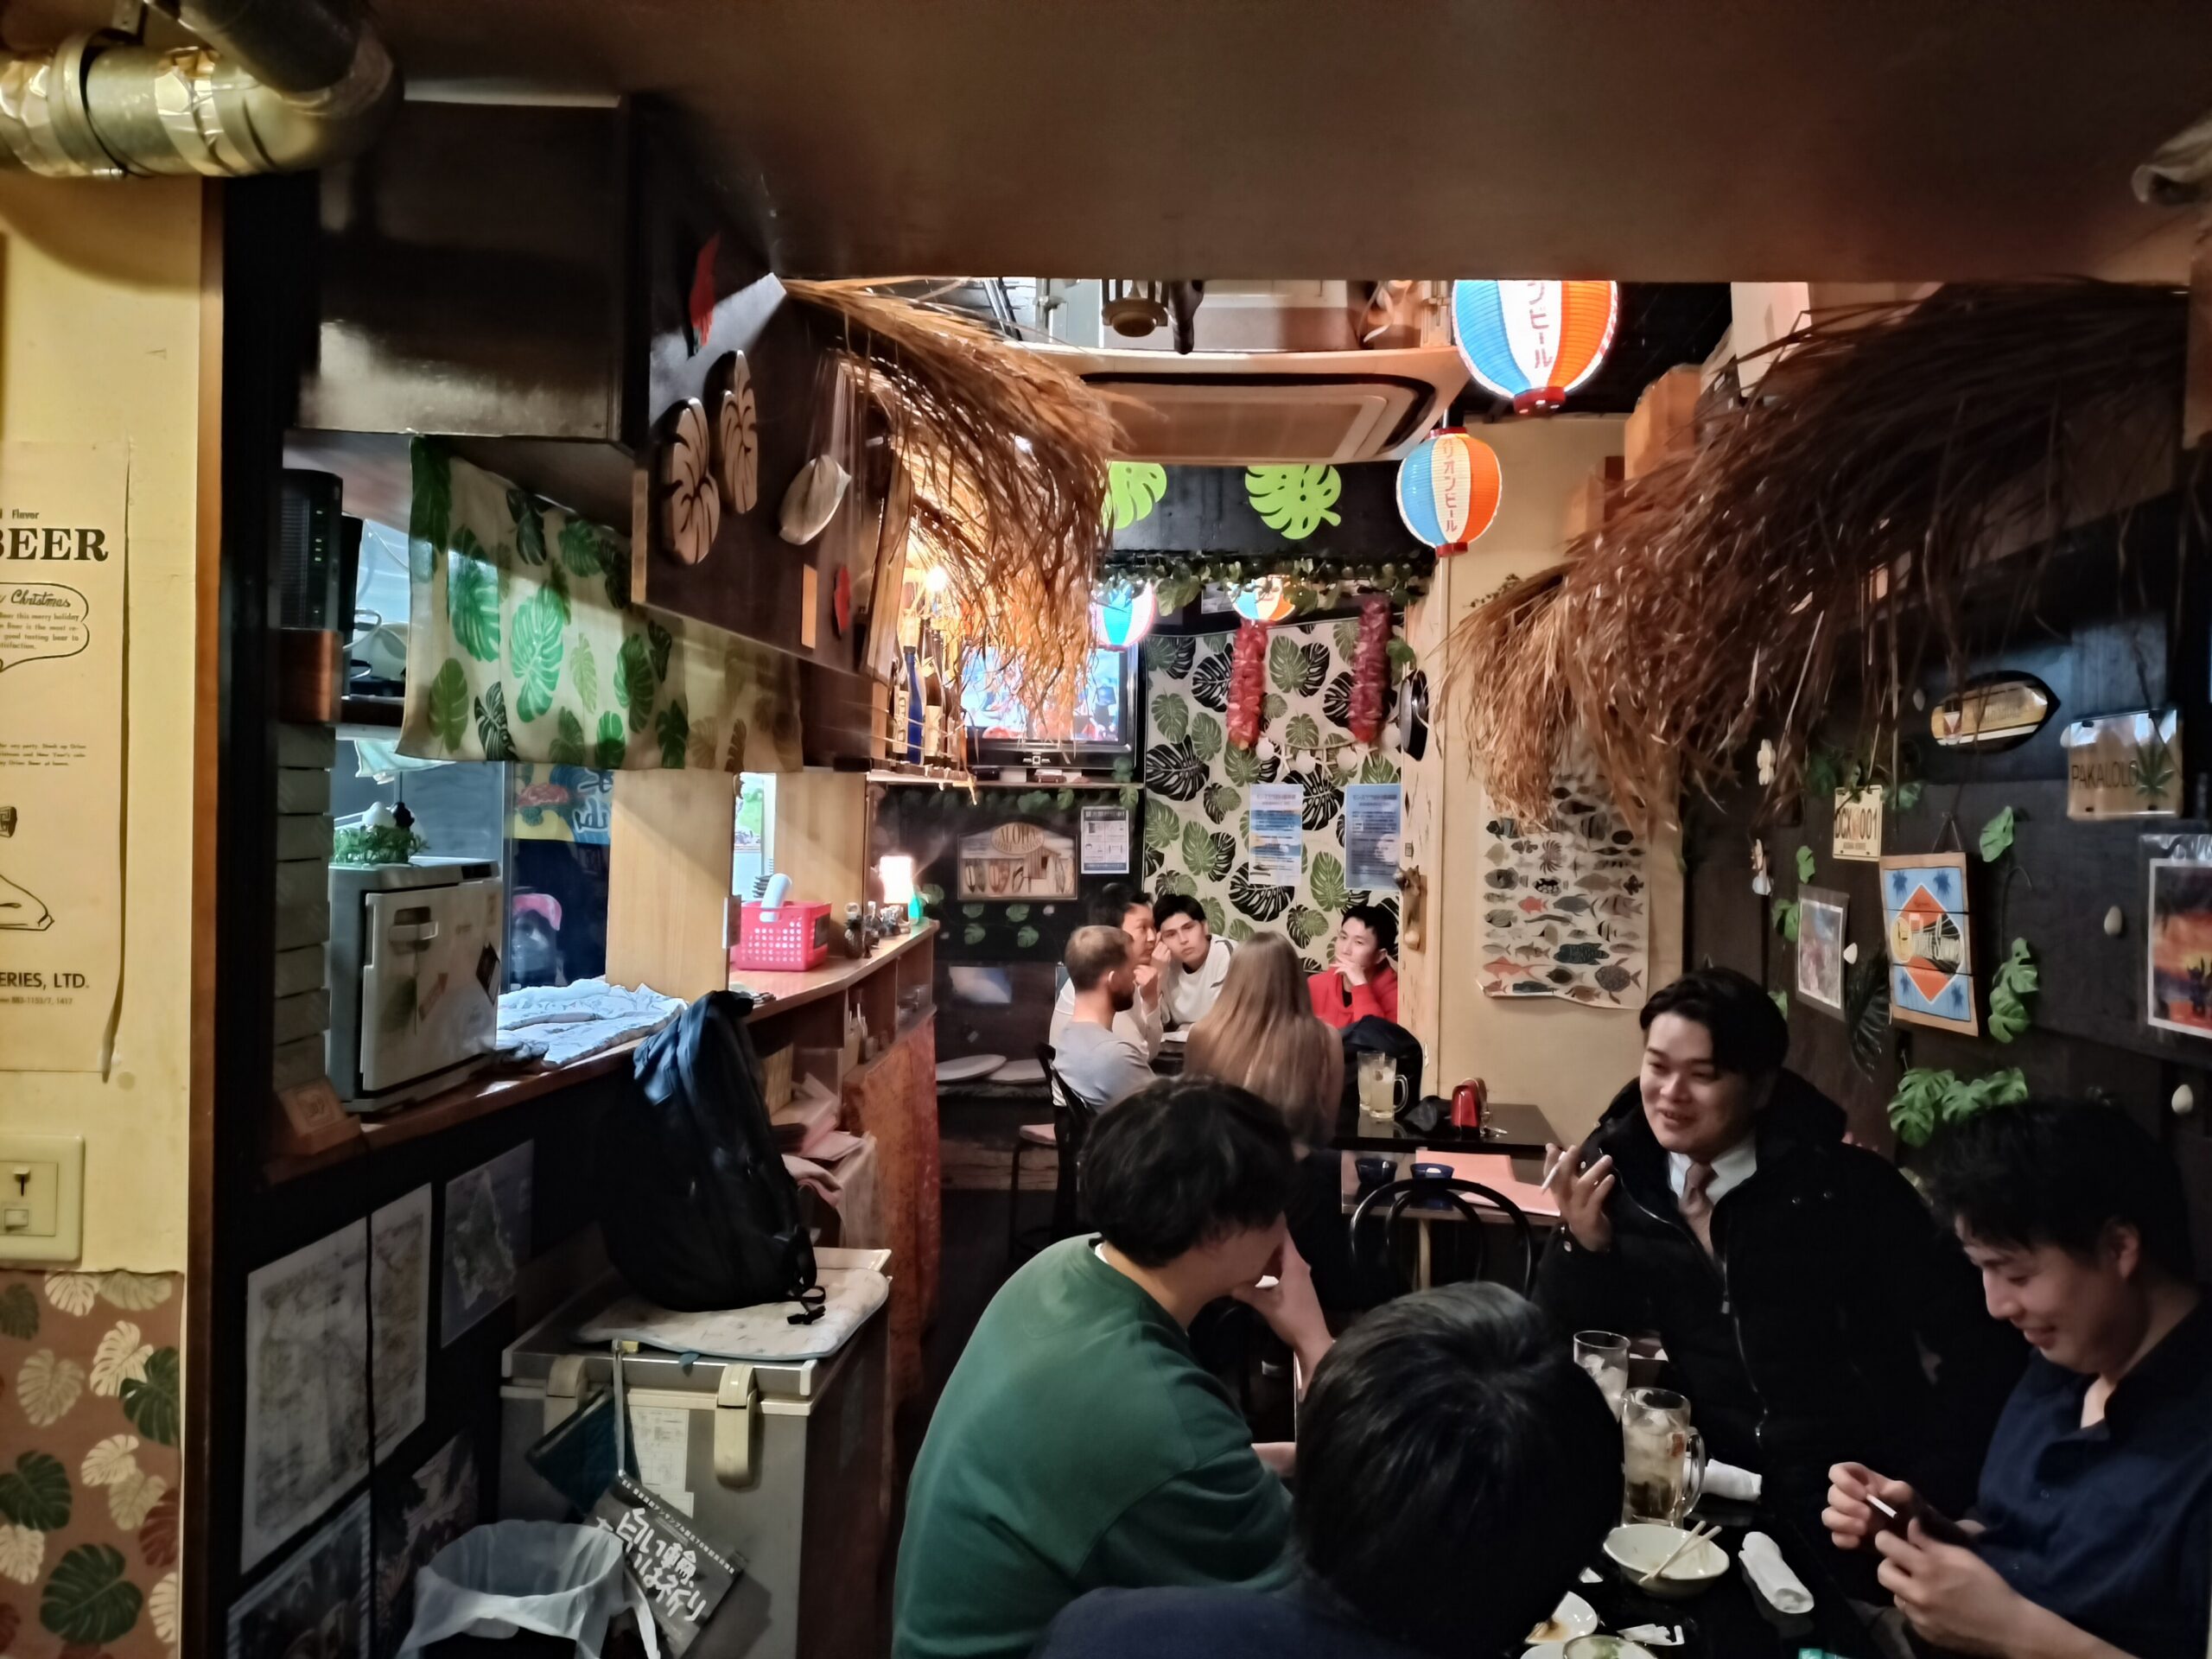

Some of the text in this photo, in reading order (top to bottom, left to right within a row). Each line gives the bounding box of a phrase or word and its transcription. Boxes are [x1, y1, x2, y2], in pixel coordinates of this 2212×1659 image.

[12, 509, 40, 519] Flavor
[0, 528, 109, 562] EER
[10, 589, 71, 607] Christmas
[2071, 760, 2139, 789] PAKALOLO
[1859, 807, 1878, 841] 001
[54, 973, 90, 989] LTD.
